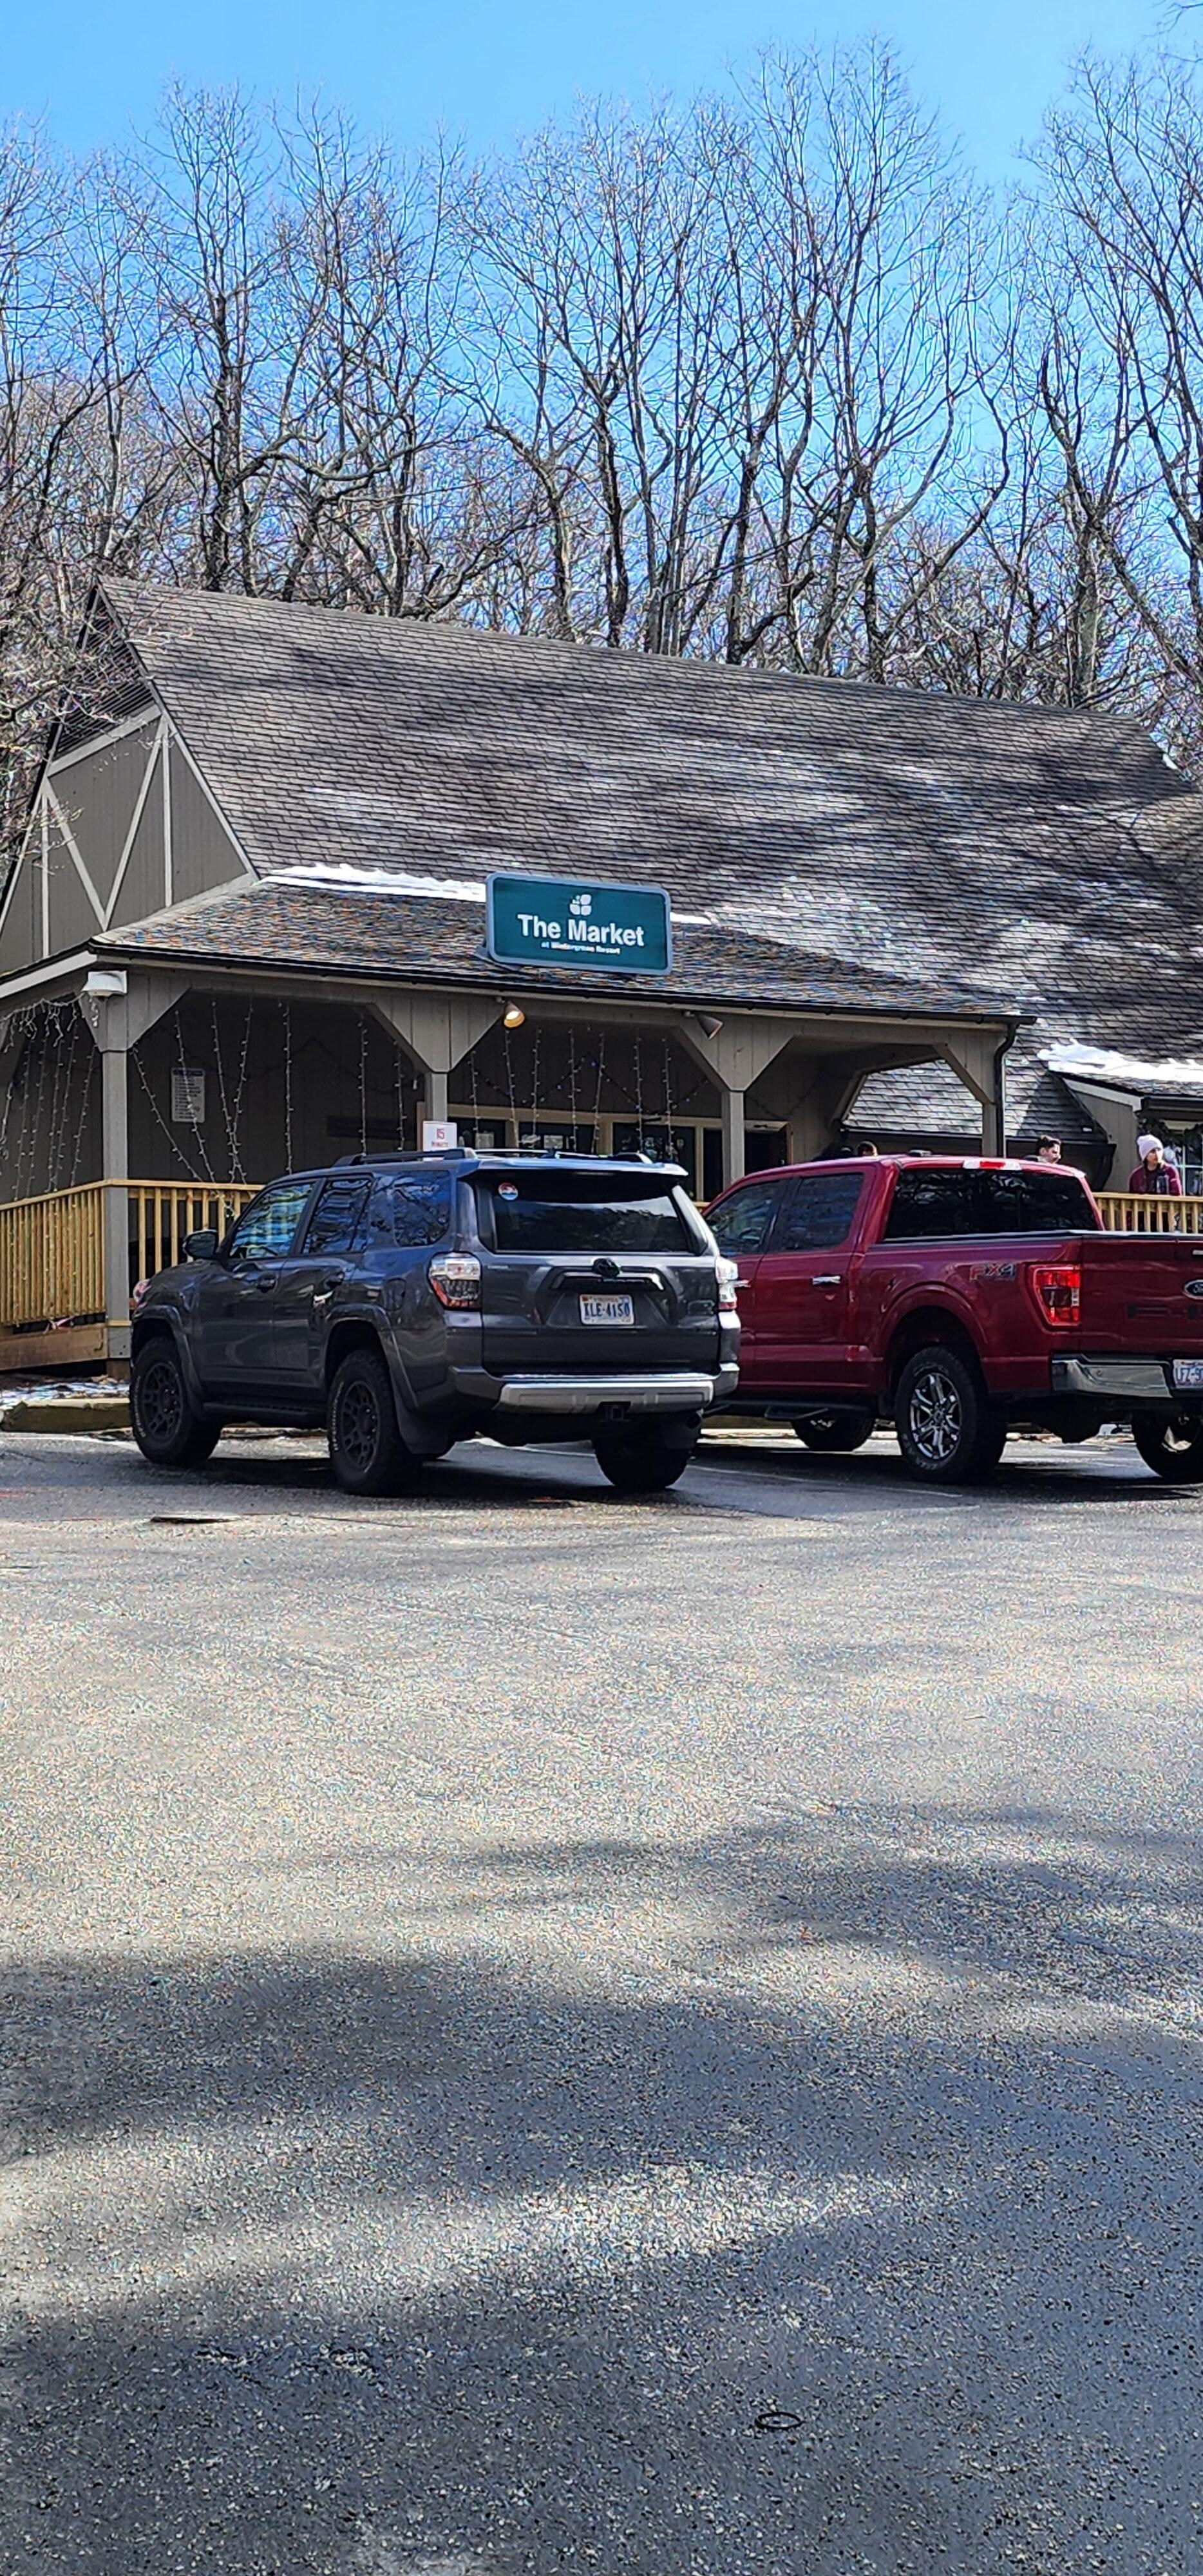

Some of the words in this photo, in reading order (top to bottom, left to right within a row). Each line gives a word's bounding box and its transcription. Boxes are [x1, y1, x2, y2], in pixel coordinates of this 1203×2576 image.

[517, 914, 561, 938] The
[568, 919, 645, 946] Market
[969, 1263, 1016, 1282] FX4
